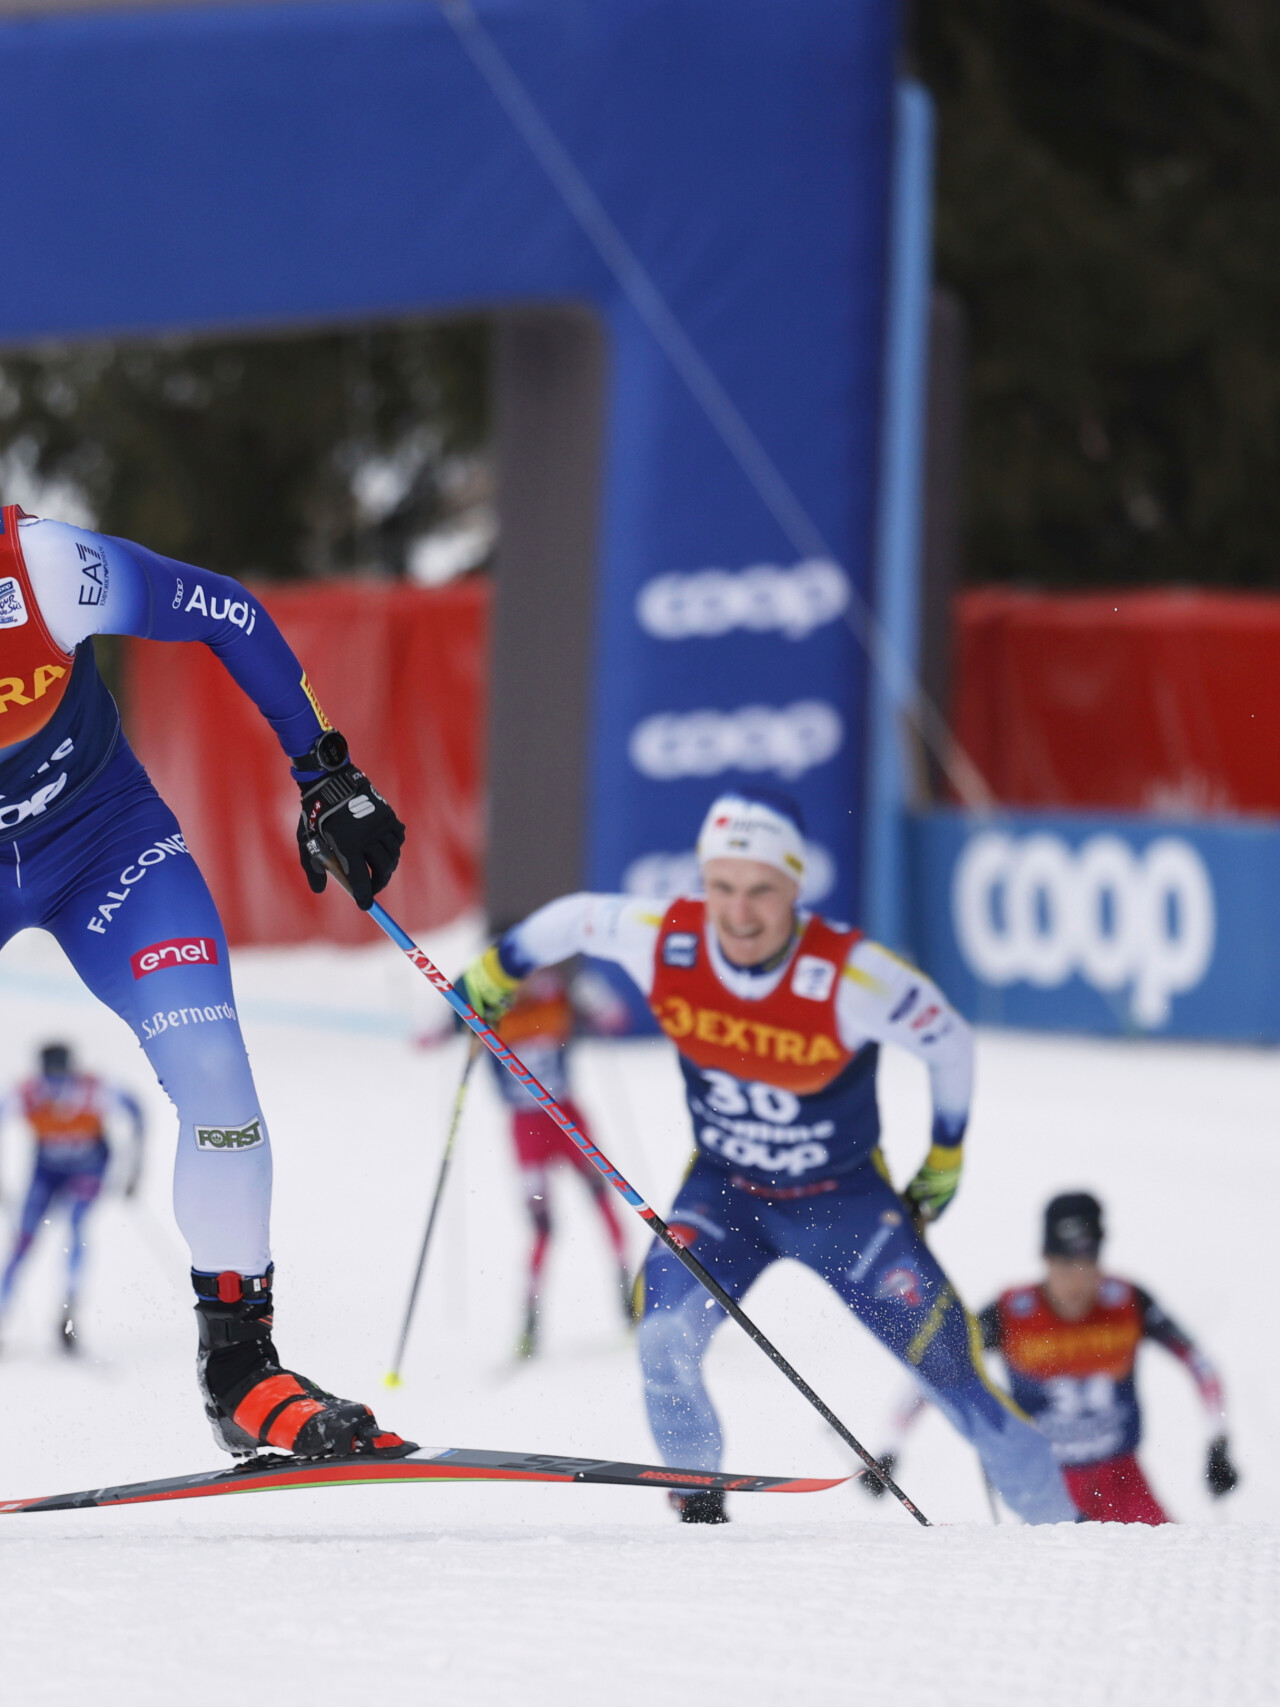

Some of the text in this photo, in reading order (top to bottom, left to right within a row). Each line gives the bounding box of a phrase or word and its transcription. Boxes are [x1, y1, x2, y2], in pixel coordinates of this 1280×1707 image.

[75, 542, 103, 606] EA7
[635, 558, 849, 641] coop
[184, 584, 257, 636] Audi
[628, 699, 842, 782] coop
[139, 939, 210, 971] enel
[953, 829, 1215, 1030] coop
[141, 1001, 236, 1040] S.Bernardo
[694, 1006, 840, 1066] EXTRA
[699, 1068, 801, 1126] 30
[197, 1120, 261, 1149] FORST
